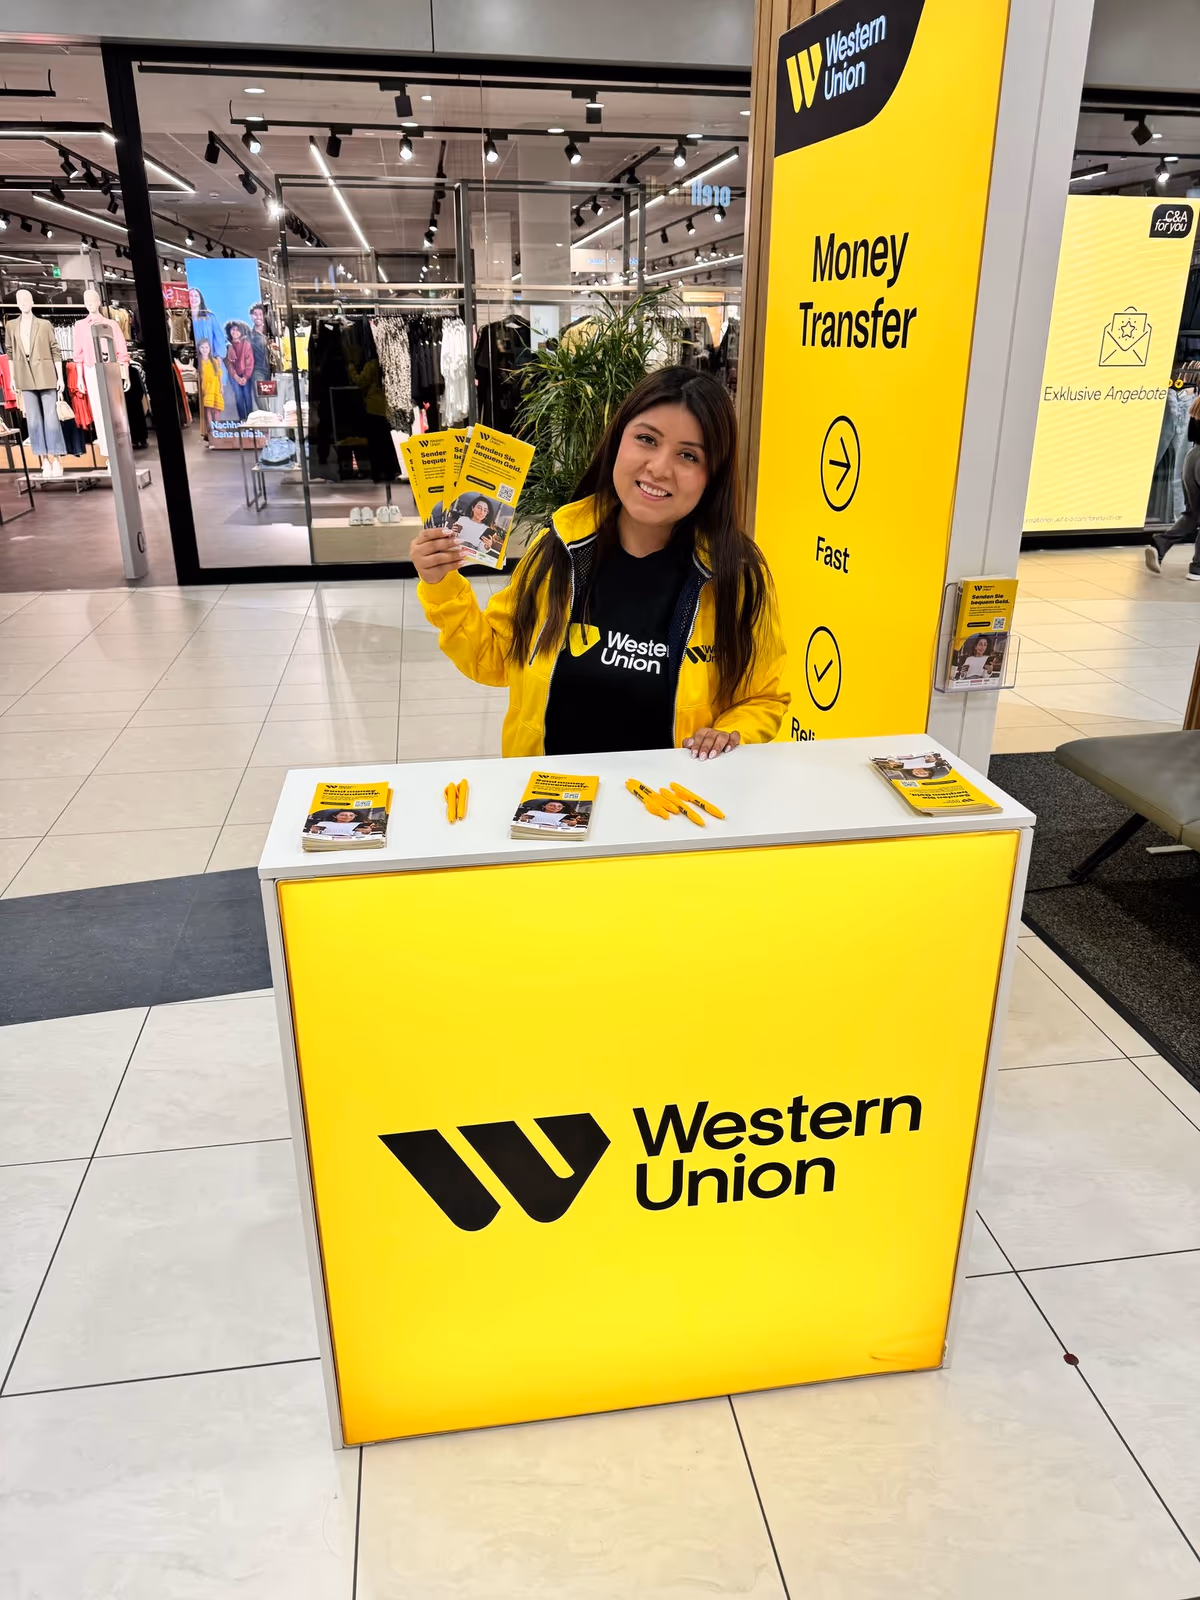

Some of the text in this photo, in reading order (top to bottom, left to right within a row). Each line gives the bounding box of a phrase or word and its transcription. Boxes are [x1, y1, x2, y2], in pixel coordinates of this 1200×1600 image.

[825, 14, 887, 67] Western
[824, 61, 865, 101] Union
[1154, 218, 1188, 234] for you
[1165, 210, 1188, 223] C&A
[812, 231, 909, 289] Money
[799, 297, 917, 349] Transfer
[1043, 385, 1167, 404] Exklusive Angebote
[212, 430, 233, 438] Ganz
[473, 449, 504, 466] bequem
[503, 461, 522, 473] Geld.
[475, 442, 503, 458] Senden
[503, 453, 516, 463] Sie
[815, 535, 850, 574] Fast
[600, 647, 661, 674] Union
[632, 1095, 922, 1157] Western
[636, 1153, 835, 1211] Union
